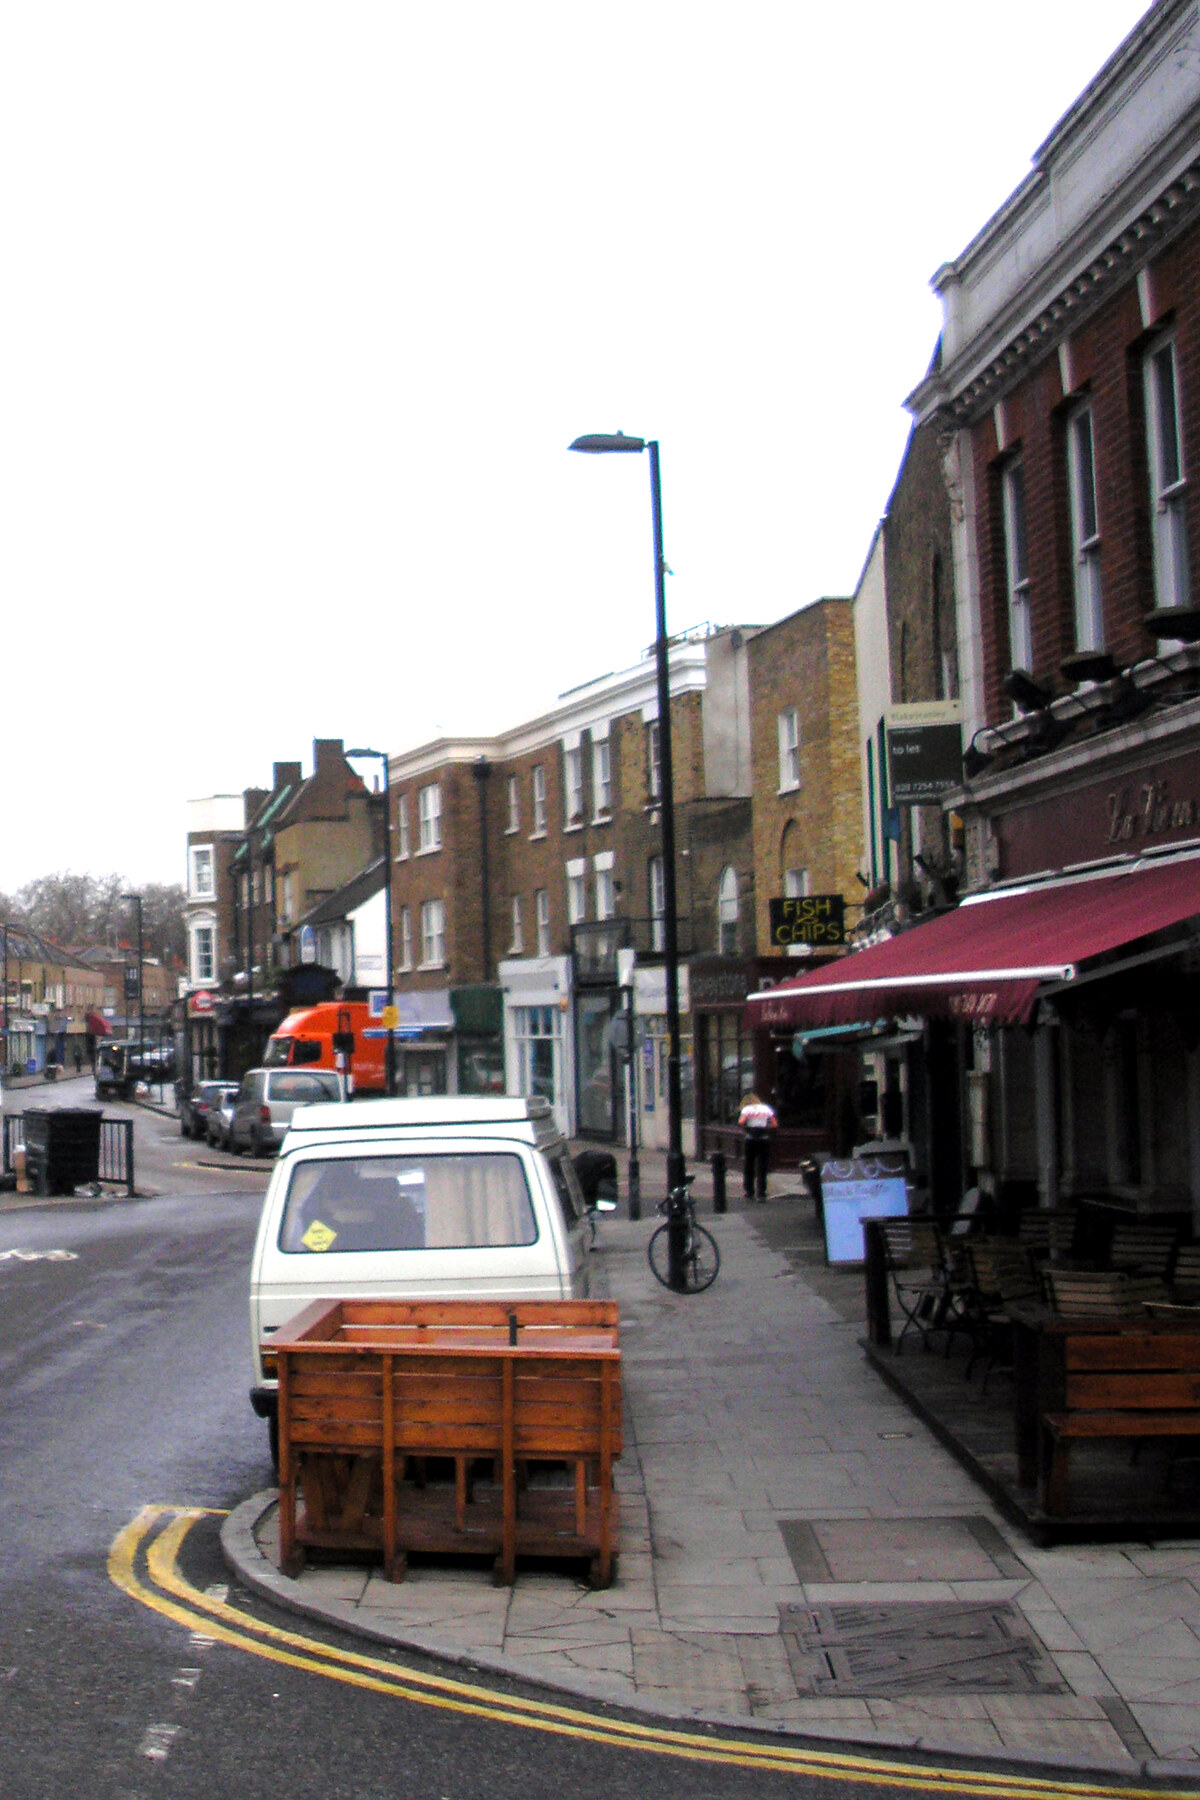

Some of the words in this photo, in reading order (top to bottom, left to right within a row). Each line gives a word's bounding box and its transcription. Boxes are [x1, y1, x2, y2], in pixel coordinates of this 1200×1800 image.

[893, 746, 904, 755] to
[906, 743, 921, 753] let
[783, 899, 831, 917] FISH
[776, 921, 840, 944] CHIPS
